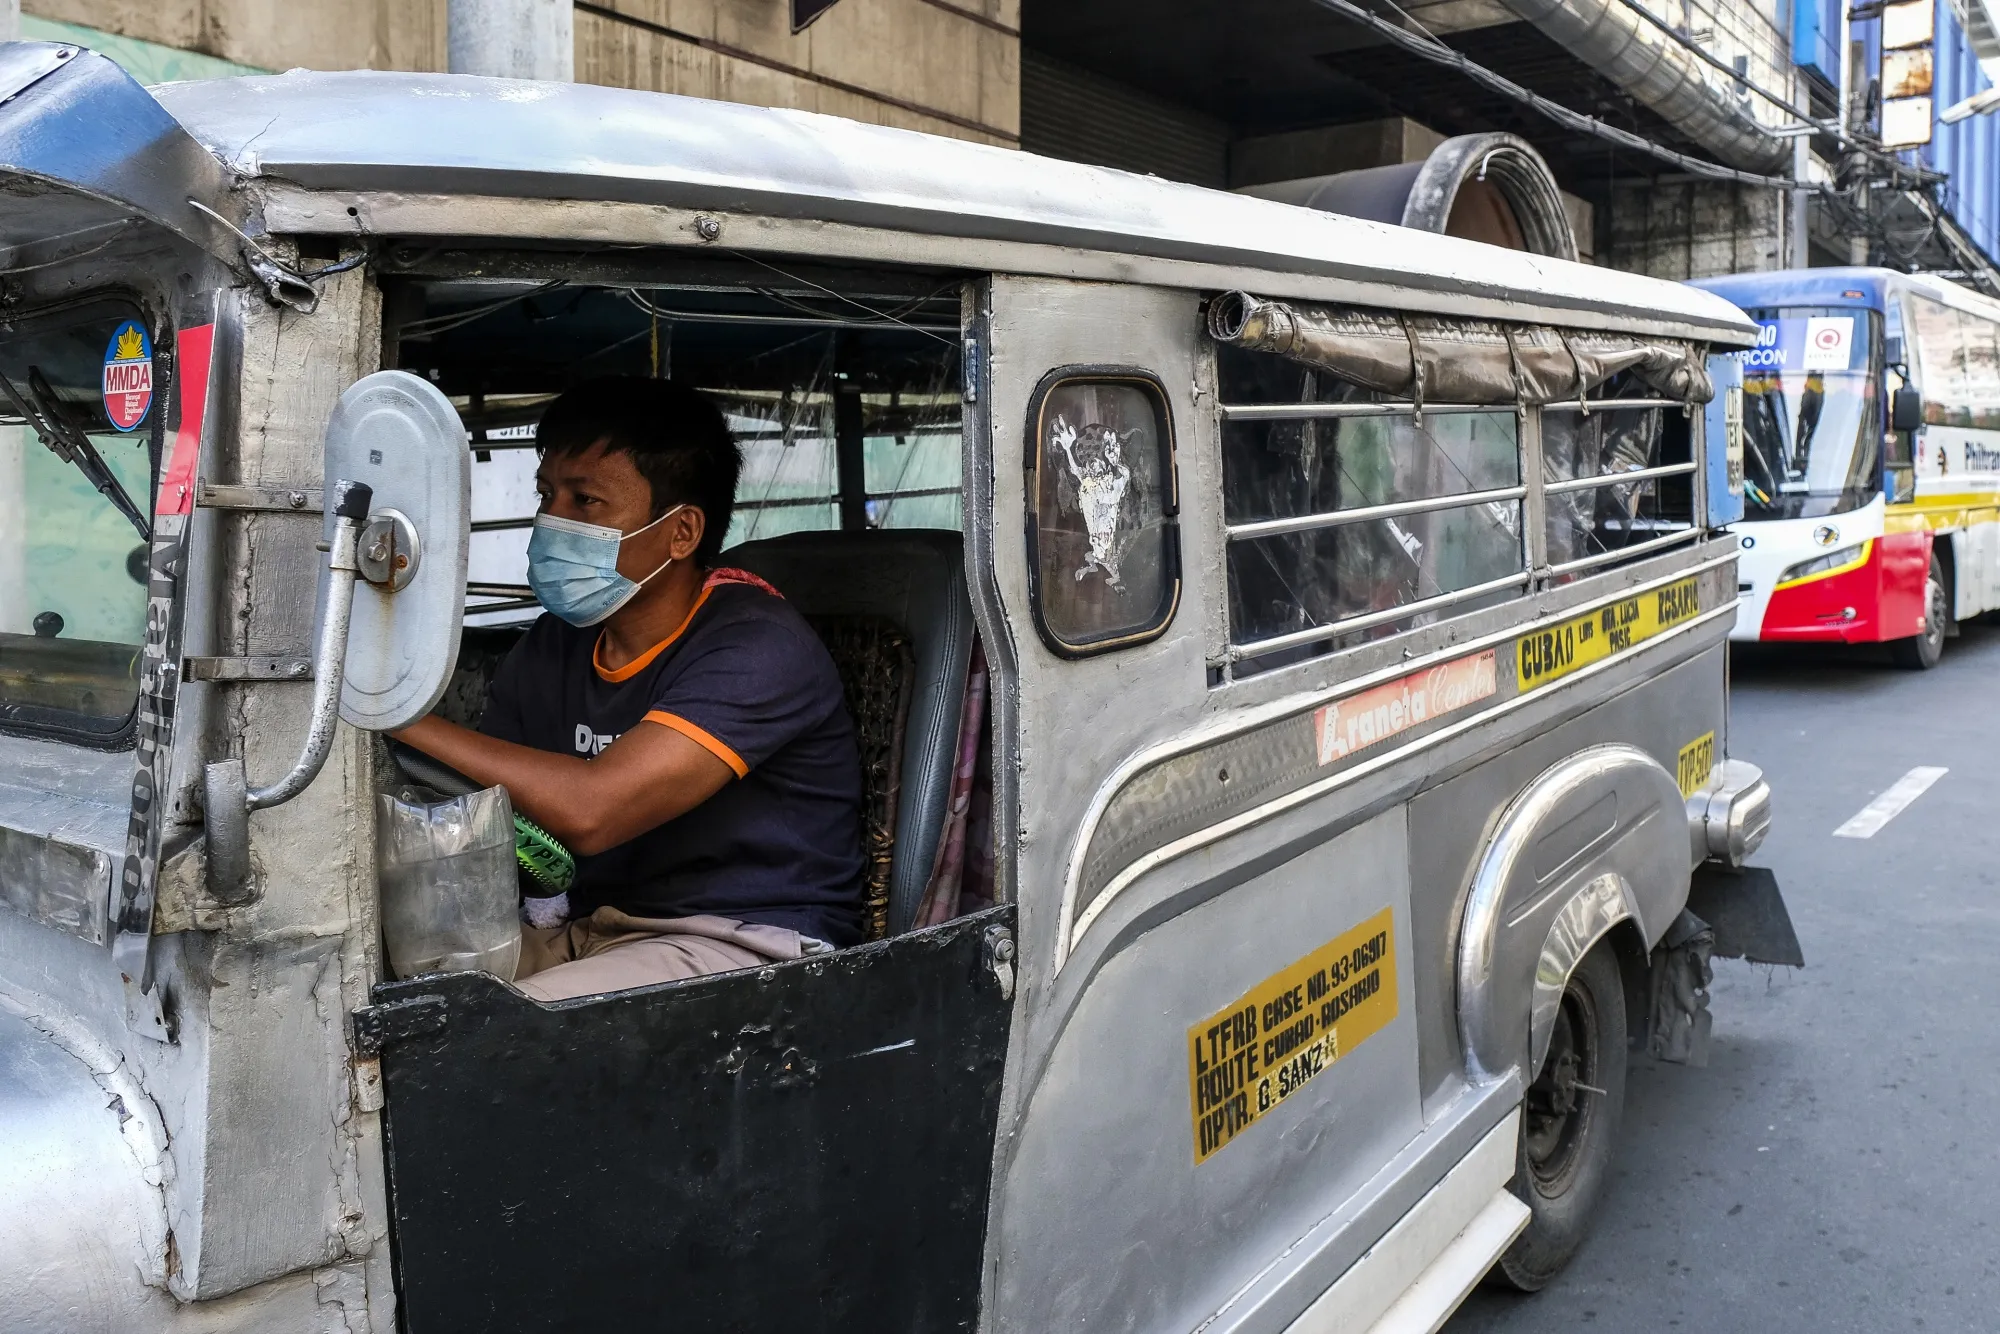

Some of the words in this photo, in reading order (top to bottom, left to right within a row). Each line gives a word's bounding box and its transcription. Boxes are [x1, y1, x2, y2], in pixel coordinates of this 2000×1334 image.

[106, 364, 151, 392] MMDA
[1521, 625, 1574, 681] CUBAO
[122, 529, 182, 900] Marlboro
[575, 723, 622, 755] DIE
[1321, 686, 1427, 766] Araneta
[515, 826, 573, 888] YPER
[1195, 1004, 1258, 1076] LTFRB
[1262, 983, 1303, 1033] CASE
[1196, 1041, 1260, 1117] ROUTE
